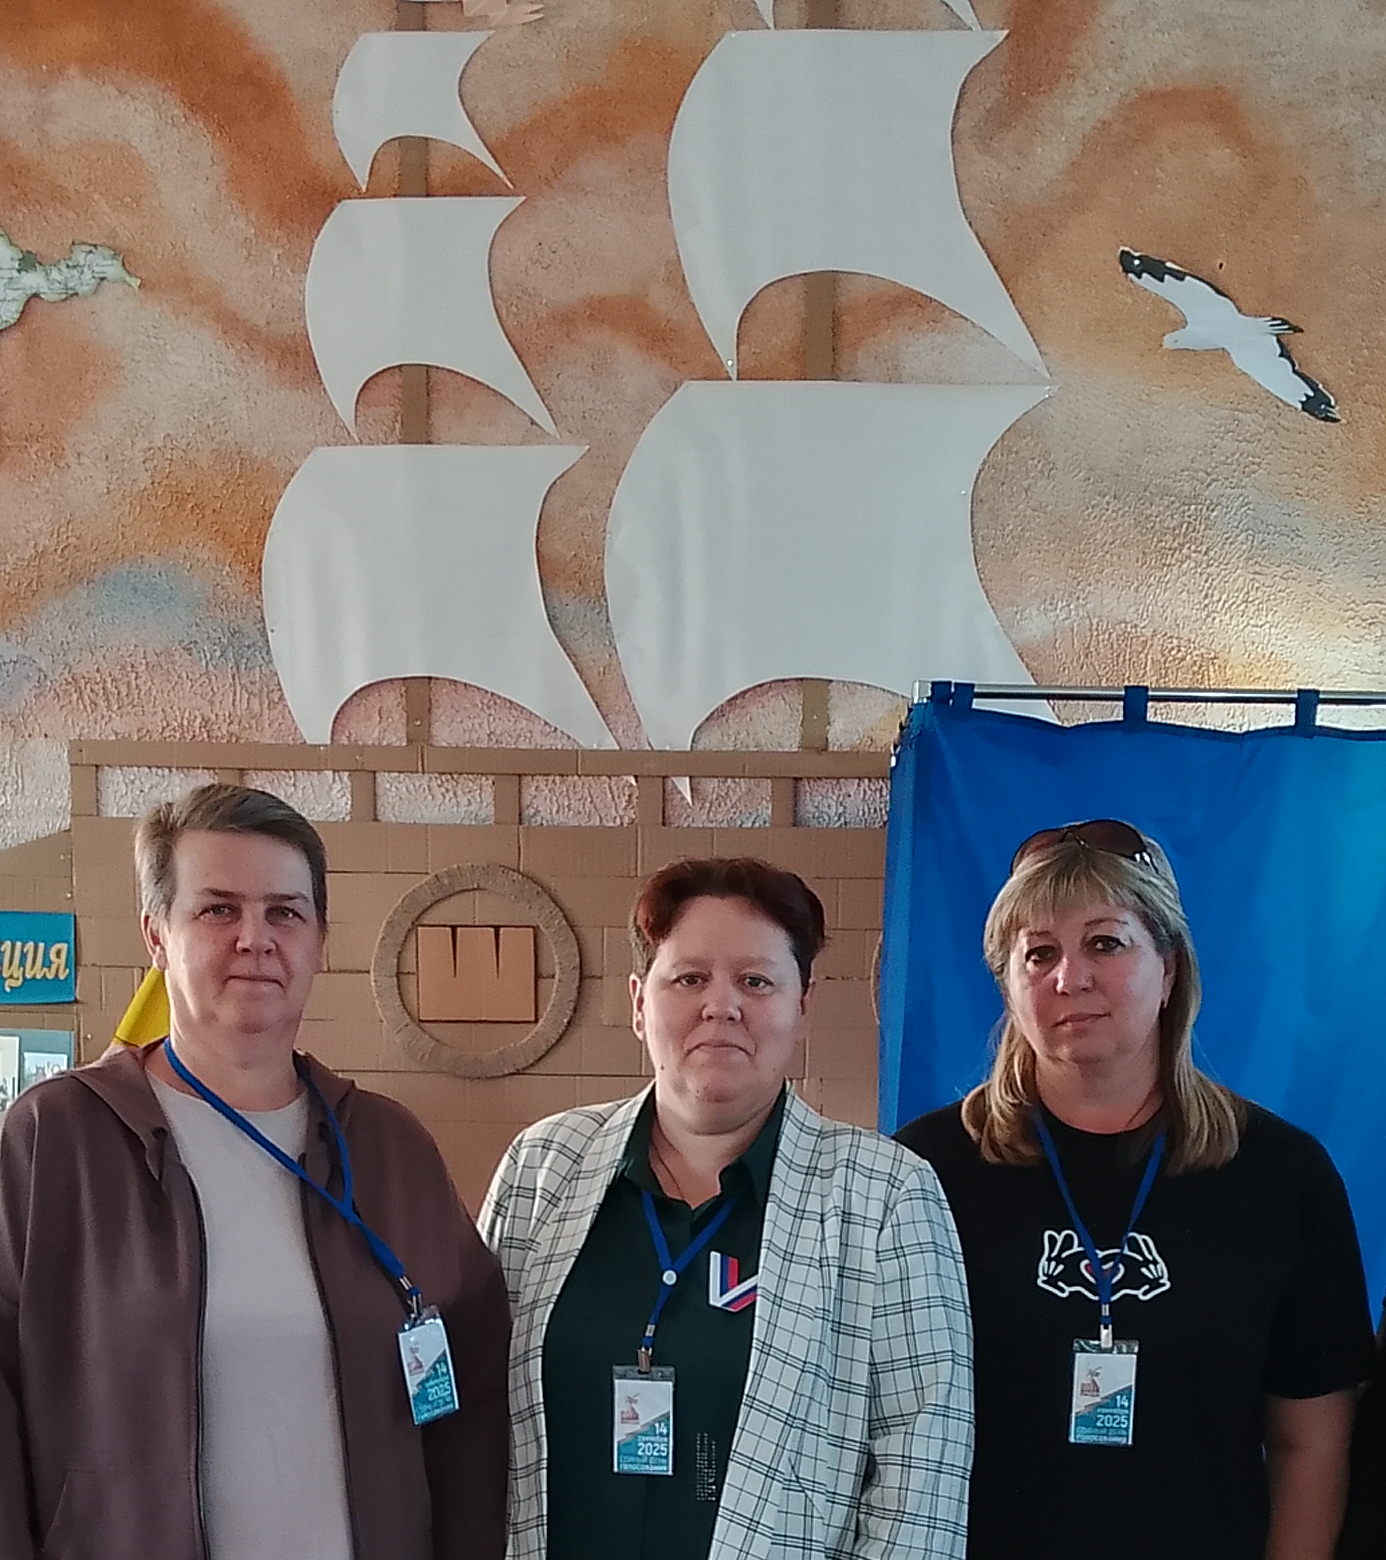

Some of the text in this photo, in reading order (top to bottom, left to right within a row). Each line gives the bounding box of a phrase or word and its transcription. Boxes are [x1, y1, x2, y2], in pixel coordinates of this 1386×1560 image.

[1115, 1395, 1129, 1408] 14
[1096, 1414, 1128, 1428] 2025
[654, 1422, 668, 1435] 14
[637, 1442, 668, 1456] 2025
